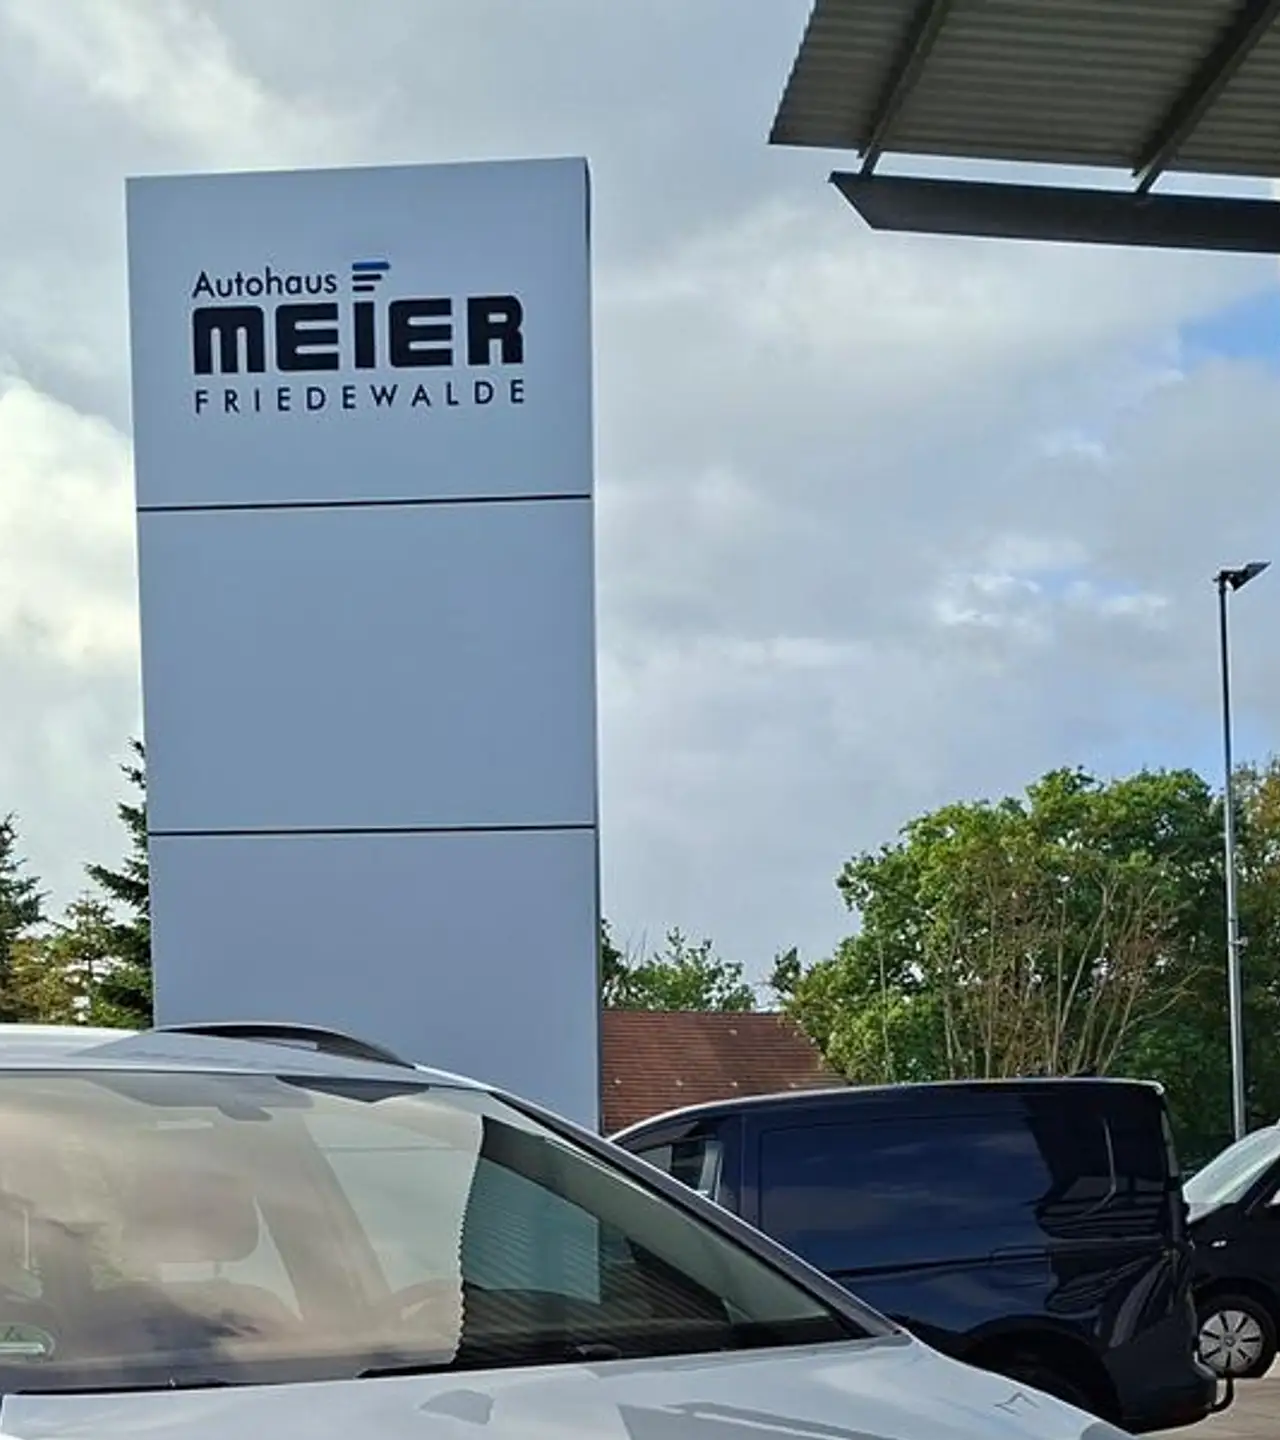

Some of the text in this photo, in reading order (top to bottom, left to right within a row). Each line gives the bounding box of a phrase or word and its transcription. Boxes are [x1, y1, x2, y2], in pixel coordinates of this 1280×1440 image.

[192, 266, 337, 299] Autohaus
[193, 295, 524, 376] MEIER
[195, 379, 525, 414] FRIEDEWALDE
